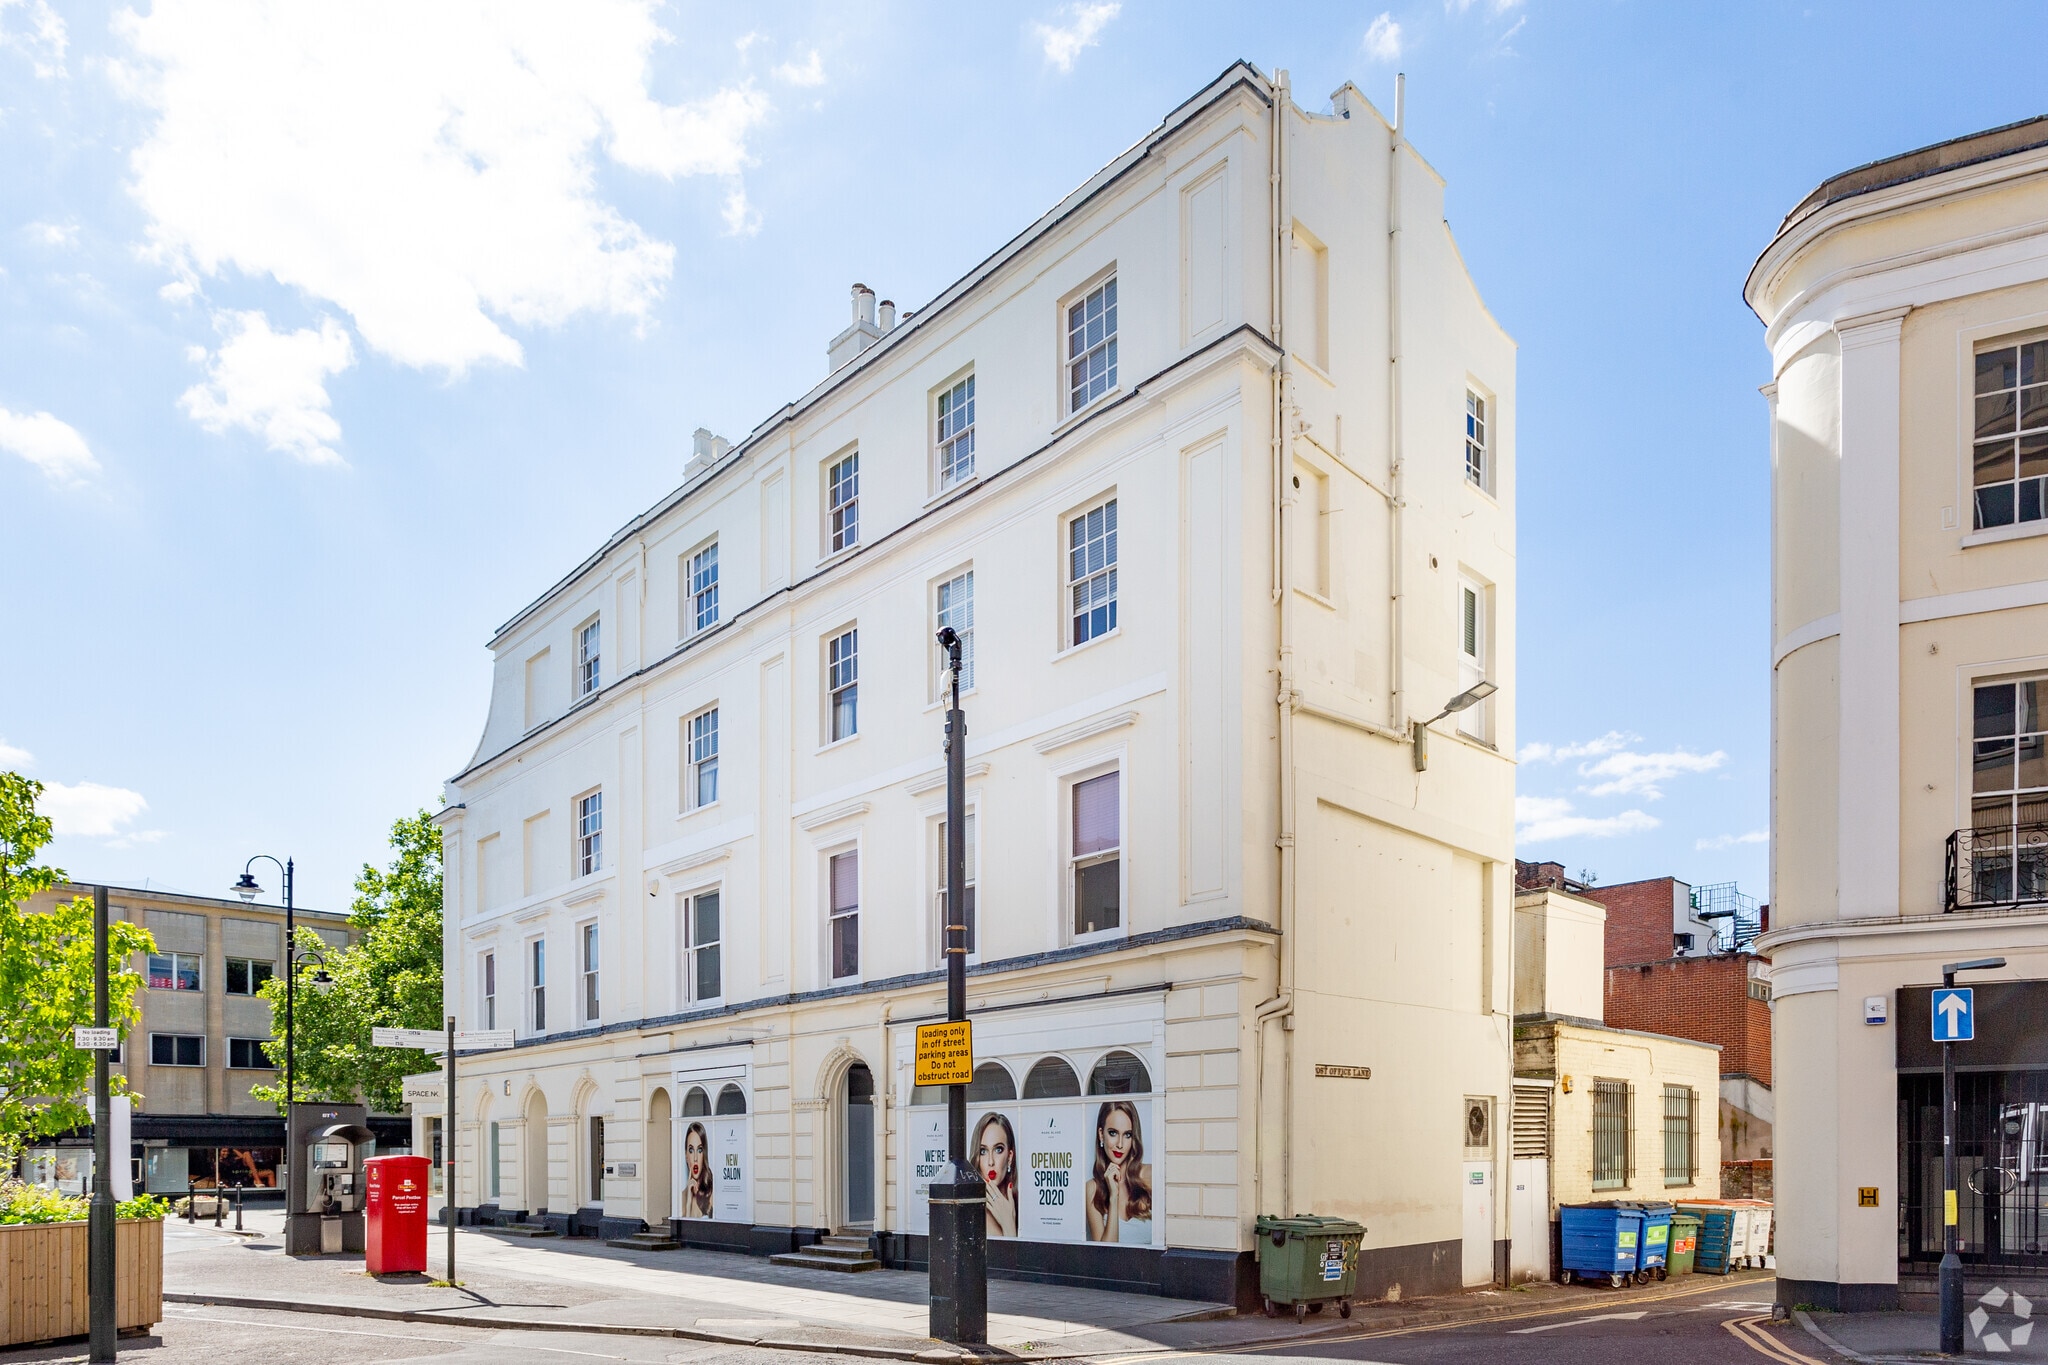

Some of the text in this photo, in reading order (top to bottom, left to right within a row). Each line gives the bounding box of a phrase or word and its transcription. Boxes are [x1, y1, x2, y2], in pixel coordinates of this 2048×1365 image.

[922, 1027, 965, 1038] loading only
[931, 1039, 941, 1047] off
[943, 1037, 965, 1047] street
[919, 1050, 945, 1061] parking
[932, 1061, 941, 1069] Do
[1315, 1066, 1328, 1074] OST
[918, 1070, 969, 1080] obstruct road
[726, 1154, 738, 1166] NEW
[925, 1150, 945, 1162] WE'RE
[1031, 1152, 1072, 1168] OPENING
[723, 1168, 741, 1180] SALON
[1035, 1171, 1068, 1187] SPRING
[1040, 1189, 1064, 1206] 2020
[1861, 1189, 1876, 1204] H
